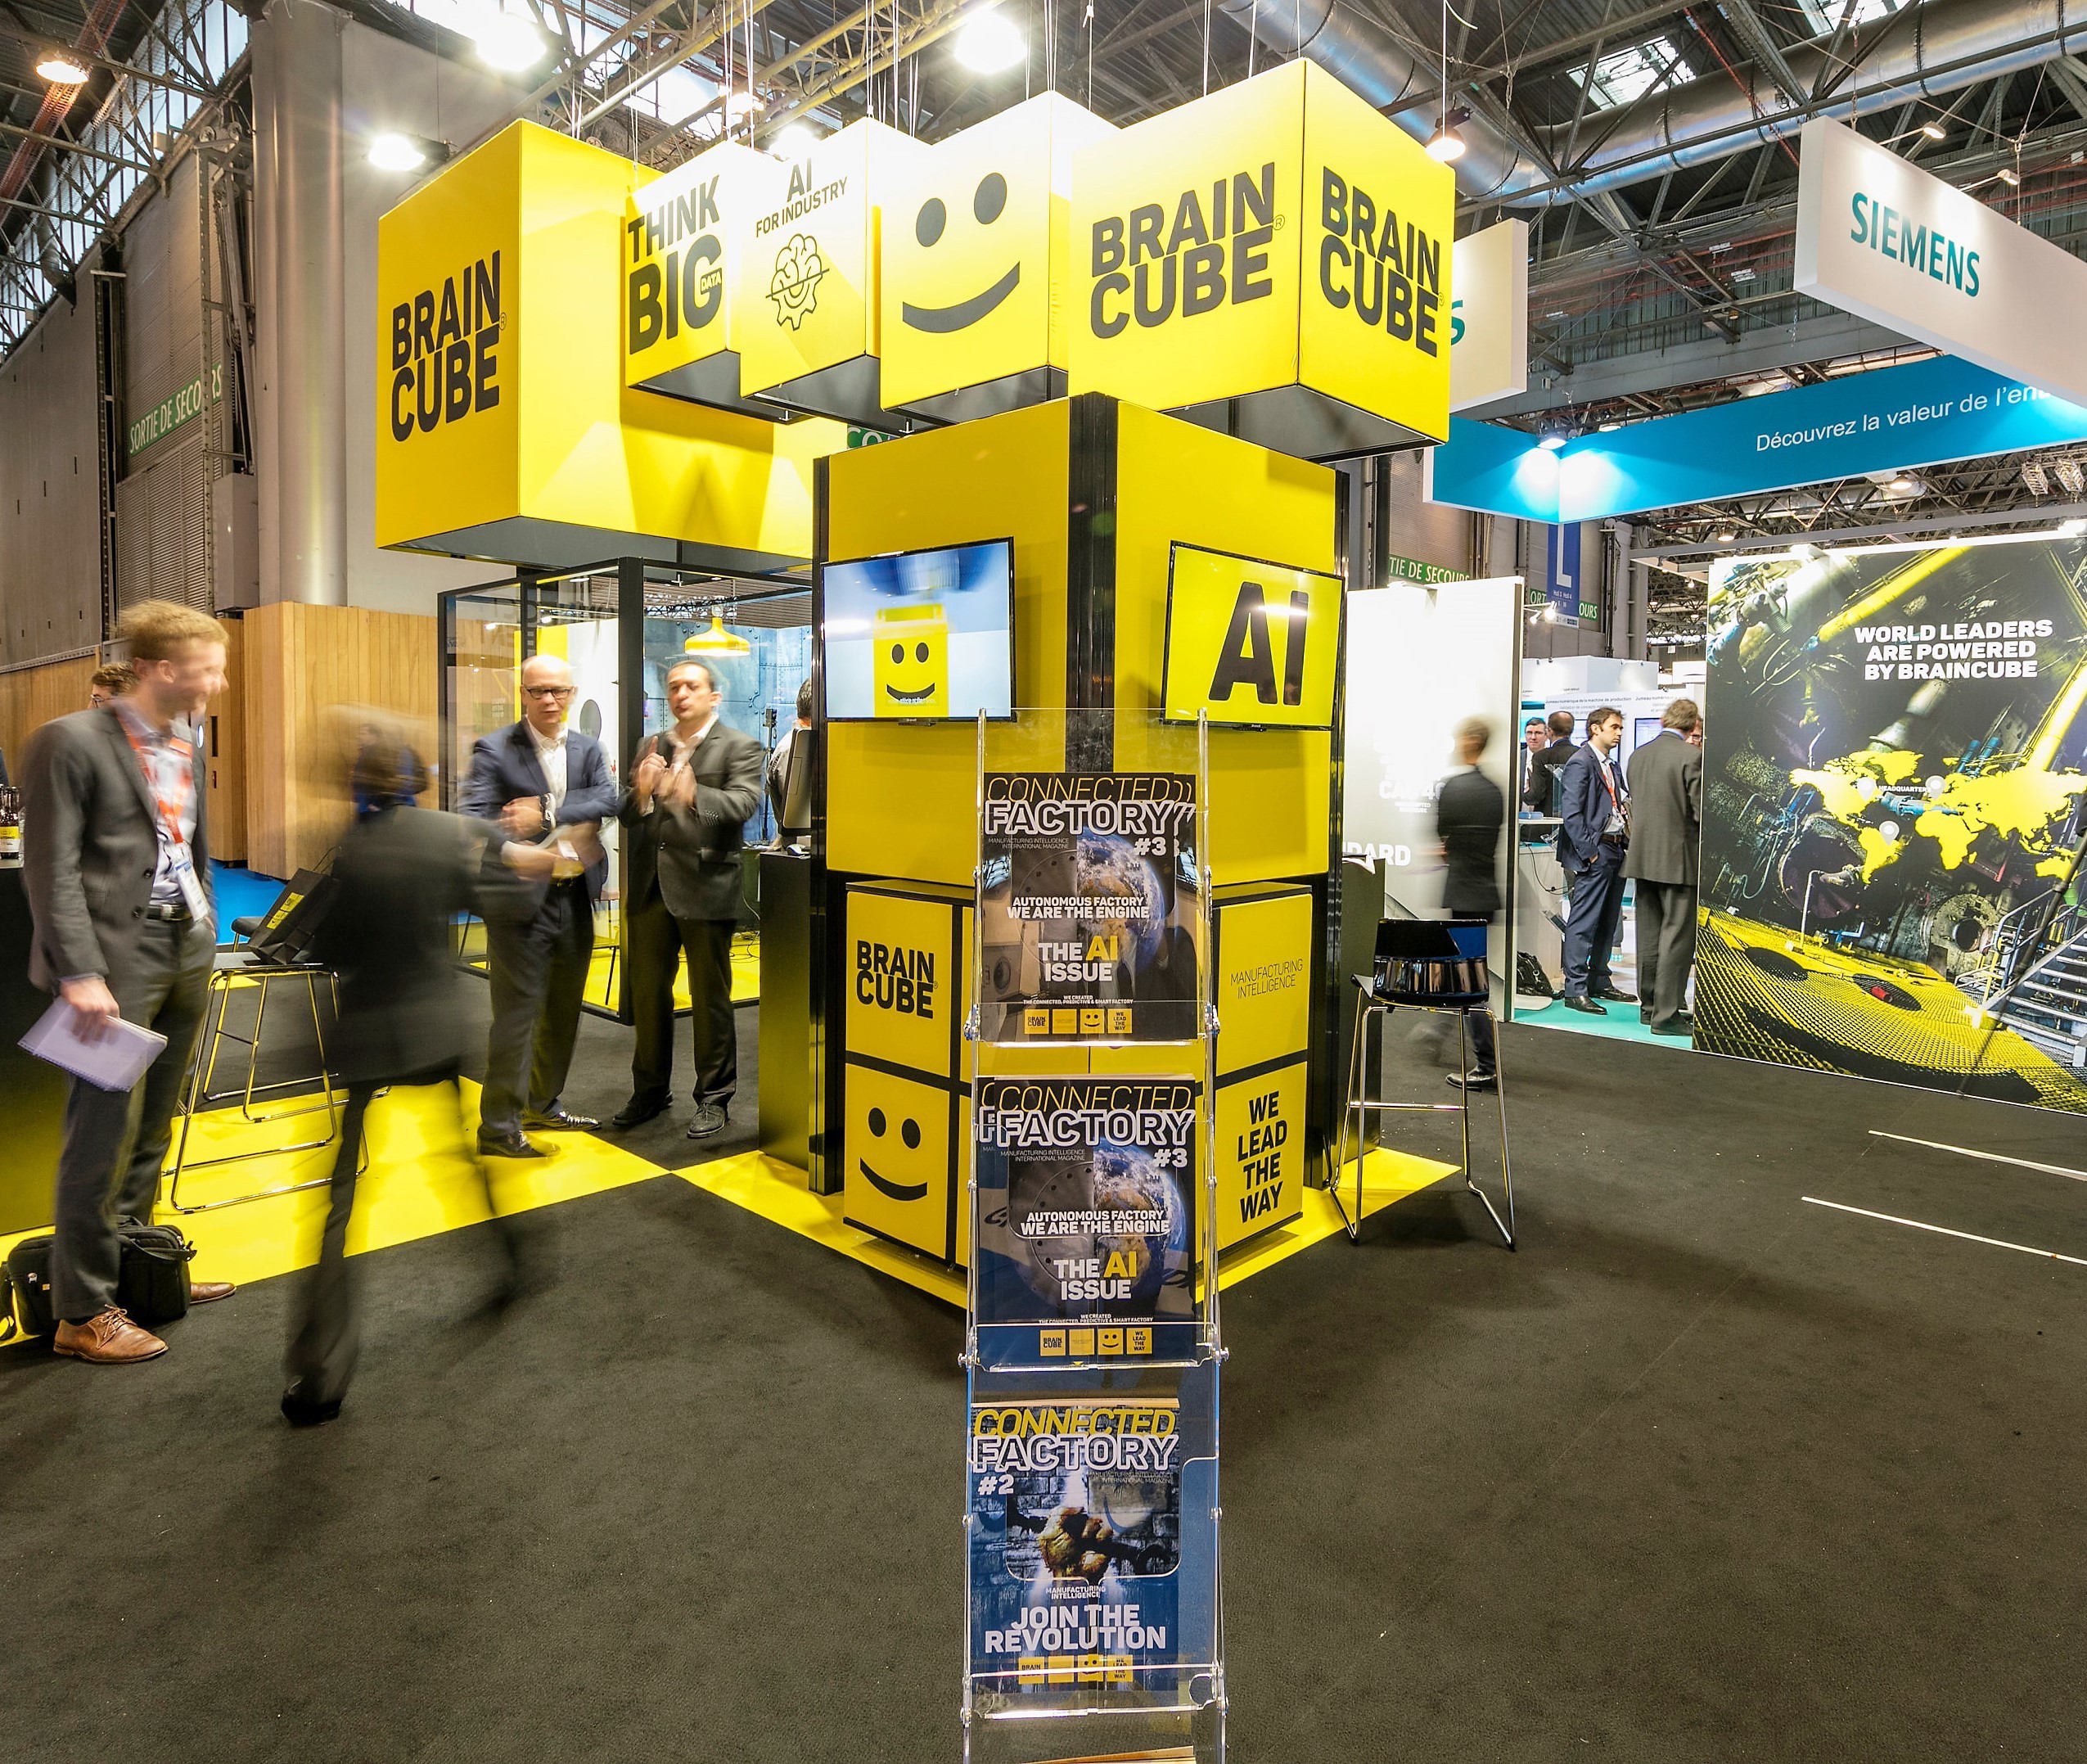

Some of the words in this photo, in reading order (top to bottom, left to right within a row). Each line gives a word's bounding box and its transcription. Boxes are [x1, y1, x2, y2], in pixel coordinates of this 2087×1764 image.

[787, 158, 812, 202] AI
[628, 174, 720, 264] THINK
[755, 211, 779, 238] FOR
[782, 176, 849, 225] INDUSTRY
[1092, 162, 1275, 277] BRAIN
[1322, 166, 1440, 295] BRAIN
[1850, 192, 1980, 297] SIEMENS
[629, 234, 722, 355] BIG
[700, 268, 722, 294] DATA
[1090, 226, 1273, 339] CUBE
[1320, 236, 1438, 358] CUBE
[393, 250, 500, 371] BRAIN
[392, 330, 499, 442] CUBE
[130, 410, 157, 453] SORTIE
[160, 399, 172, 432] DE
[175, 364, 221, 423] SECORS
[1756, 419, 1856, 452] Découvrez
[1863, 414, 1880, 431] la
[1886, 400, 1953, 426] valeur
[1959, 393, 1987, 413] de
[1409, 562, 1422, 580] DE
[1209, 582, 1309, 706] AI
[1855, 625, 1936, 643] WORLD
[1941, 620, 2053, 640] LEADERS
[1867, 645, 1913, 661] ARE
[1917, 640, 2035, 661] POWERED
[1864, 664, 1895, 680] BY
[1898, 661, 2037, 679] BRAINCUBE
[987, 777, 1170, 802] CONNECTED
[984, 799, 1174, 835] FACTORY
[1134, 837, 1166, 856] #3
[1007, 907, 1030, 918] WE
[1032, 907, 1062, 918] ARE
[1064, 907, 1093, 918] THE
[1096, 906, 1150, 918] ENGINE
[1012, 897, 1091, 906] AUTONOMOUS
[1094, 896, 1144, 906] FACTORY
[856, 940, 935, 983] BRAIN
[1038, 942, 1083, 961] THE
[1086, 936, 1118, 961] AI
[1045, 963, 1112, 981] ISSUE
[1230, 958, 1303, 986] MANUFACTURING
[1237, 973, 1296, 999] INTELLIGENCE
[856, 970, 934, 1019] CUBE
[999, 1086, 1191, 1112] CONNECTED
[1249, 1090, 1279, 1125] WE
[997, 1109, 1195, 1147] FACTORY
[1237, 1120, 1287, 1162] LEAD
[1154, 1148, 1188, 1168] #3
[1243, 1152, 1281, 1189] THE
[1027, 1211, 1109, 1222] AUTONOMOUS
[1111, 1211, 1164, 1220] FACTORY
[1240, 1180, 1283, 1223] WAY
[1021, 1222, 1046, 1235] WE
[1048, 1221, 1079, 1234] ARE
[1081, 1220, 1111, 1234] THE
[1113, 1220, 1170, 1233] ENGINE
[1053, 1258, 1100, 1279] THE
[1103, 1252, 1137, 1278] AI
[1061, 1279, 1131, 1301] ISSUE
[973, 1409, 1176, 1438] CONNECTED
[971, 1434, 1179, 1473] FACTORY
[978, 1474, 1014, 1496] #2
[1011, 1605, 1079, 1630] JOIN
[1084, 1604, 1140, 1626] THE
[985, 1626, 1166, 1653] REVOLUTION
